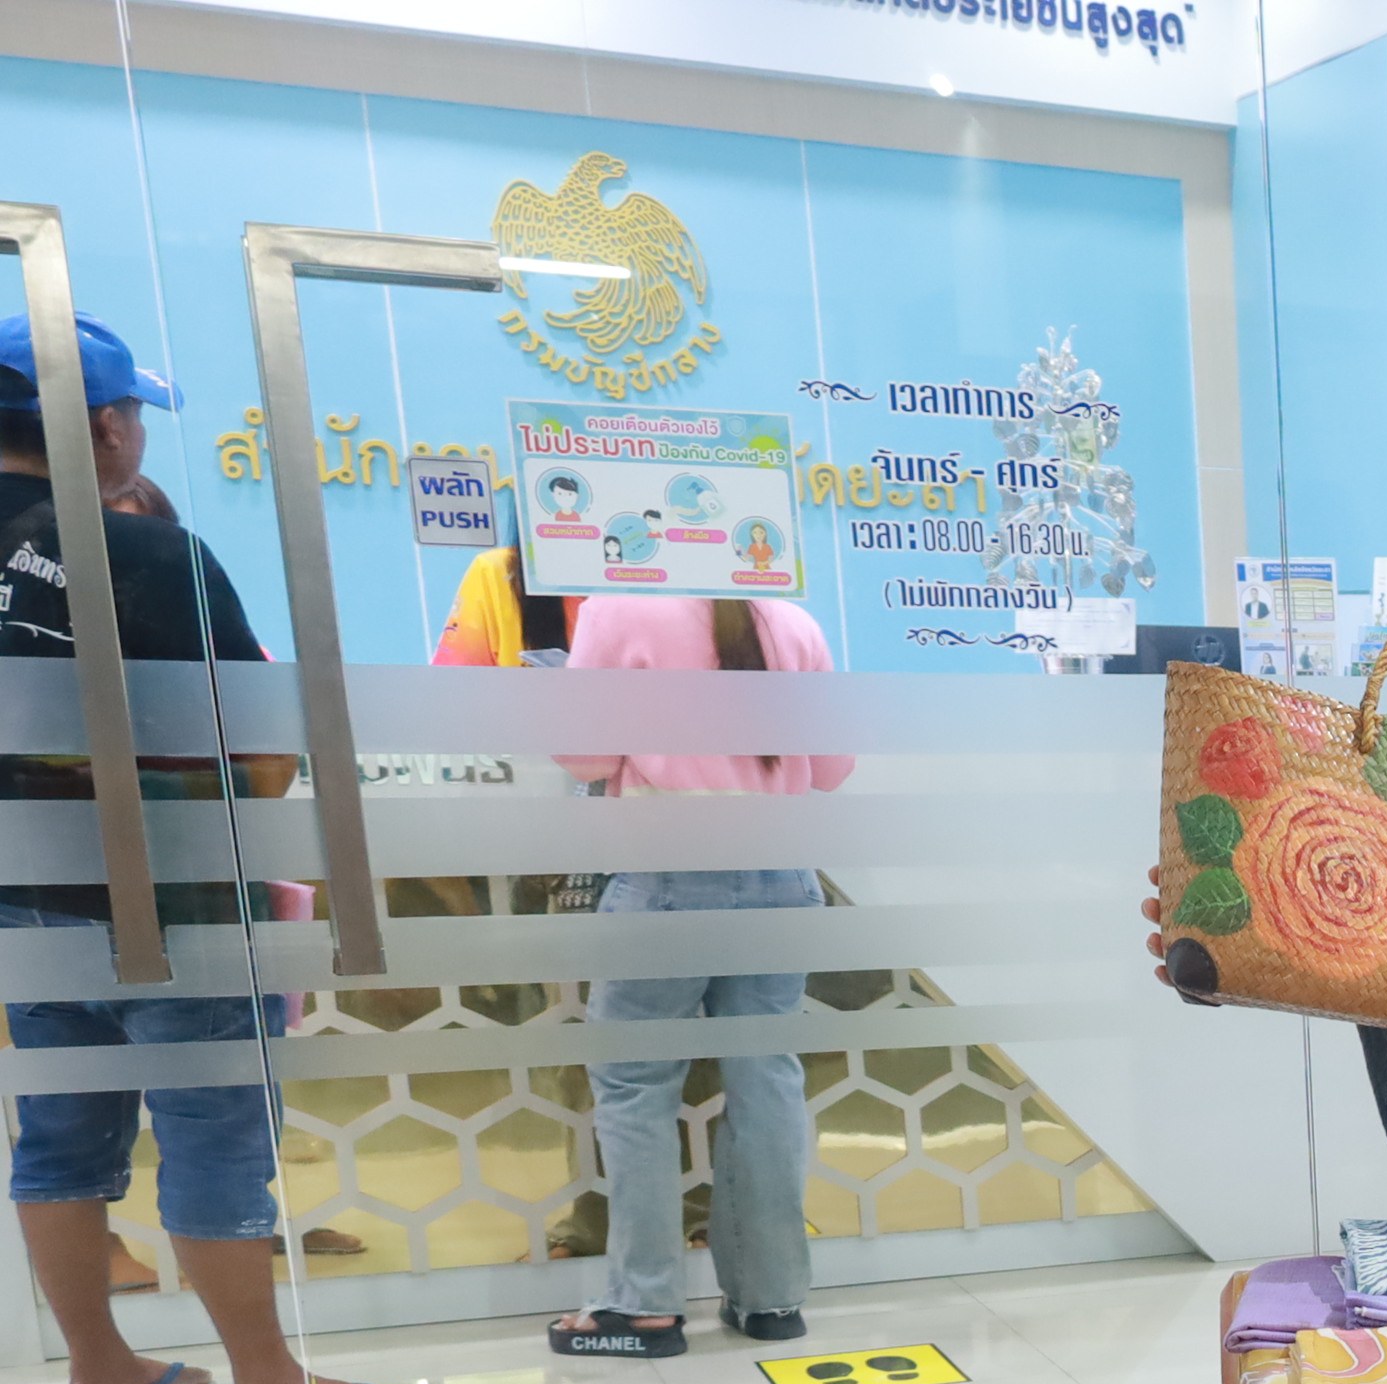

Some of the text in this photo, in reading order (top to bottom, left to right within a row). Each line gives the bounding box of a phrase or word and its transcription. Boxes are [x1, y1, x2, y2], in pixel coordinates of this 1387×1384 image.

[498, 309, 722, 400] กรมบัญชีกลาง
[889, 380, 1035, 419] เวลาทำการ
[519, 424, 786, 464] ไม่ประมาท ป้องกัน Covid-19
[587, 416, 719, 436] คอยเตือนตัวเองไว้
[871, 449, 960, 485] จันทร์
[996, 458, 1061, 493] ศุกร์
[421, 510, 490, 529] PUSH
[923, 519, 984, 552] 08.00
[1006, 522, 1064, 556] 16.30
[1072, 531, 1090, 556] น.
[571, 1336, 646, 1352] CHANEL
